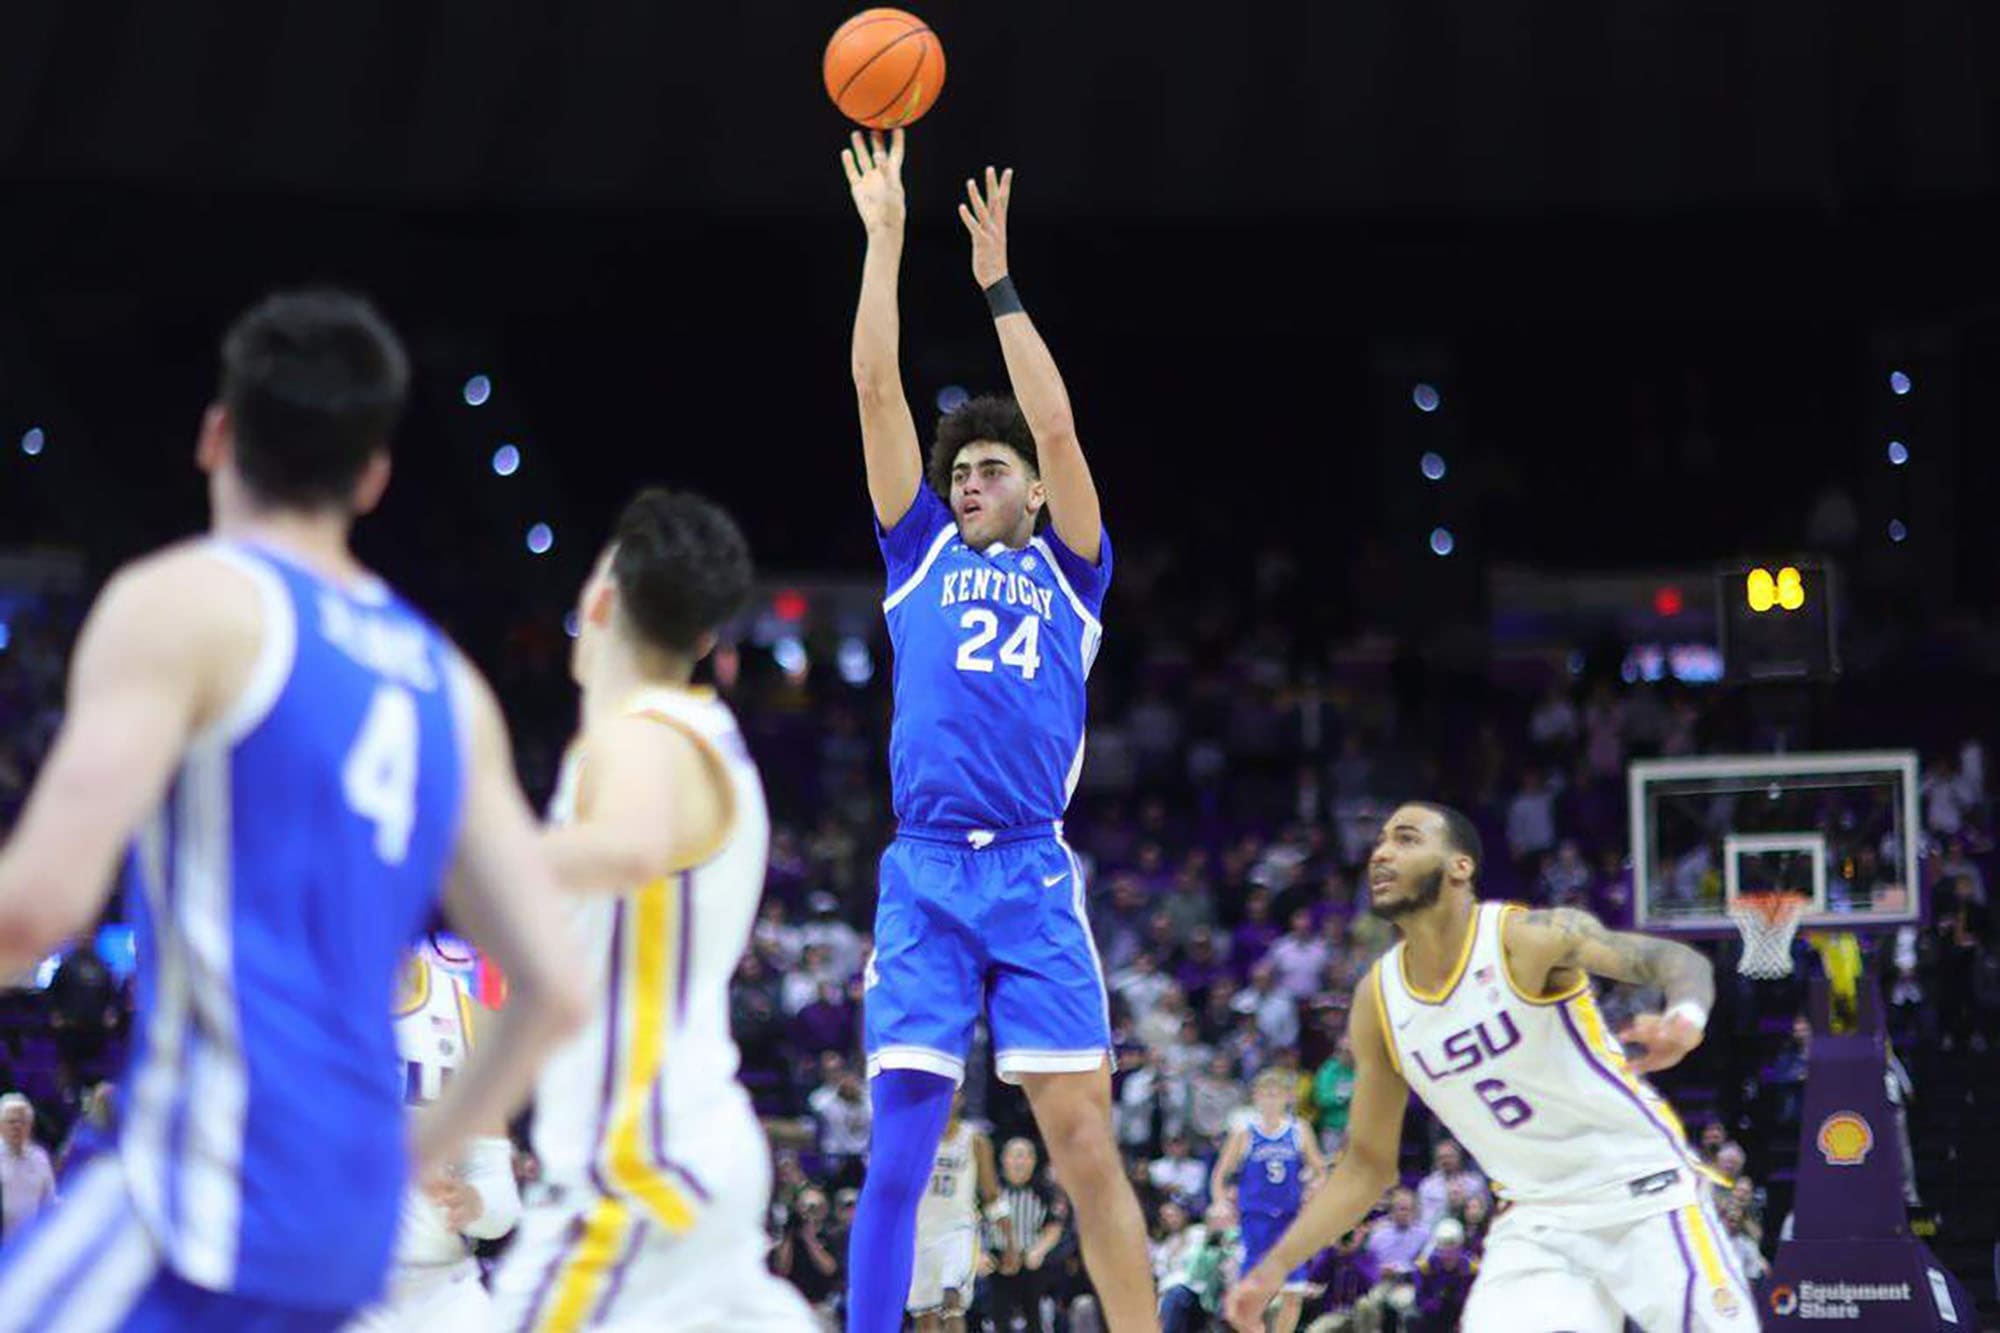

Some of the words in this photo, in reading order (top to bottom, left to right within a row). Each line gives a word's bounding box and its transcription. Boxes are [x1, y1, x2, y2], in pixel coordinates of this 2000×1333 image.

[956, 608, 1040, 679] 24
[341, 683, 420, 867] 4
[1412, 1009, 1522, 1080] LSU
[1474, 1078, 1533, 1130] 6
[1799, 1281, 1911, 1302] Equipment
[1799, 1303, 1860, 1319] Share
